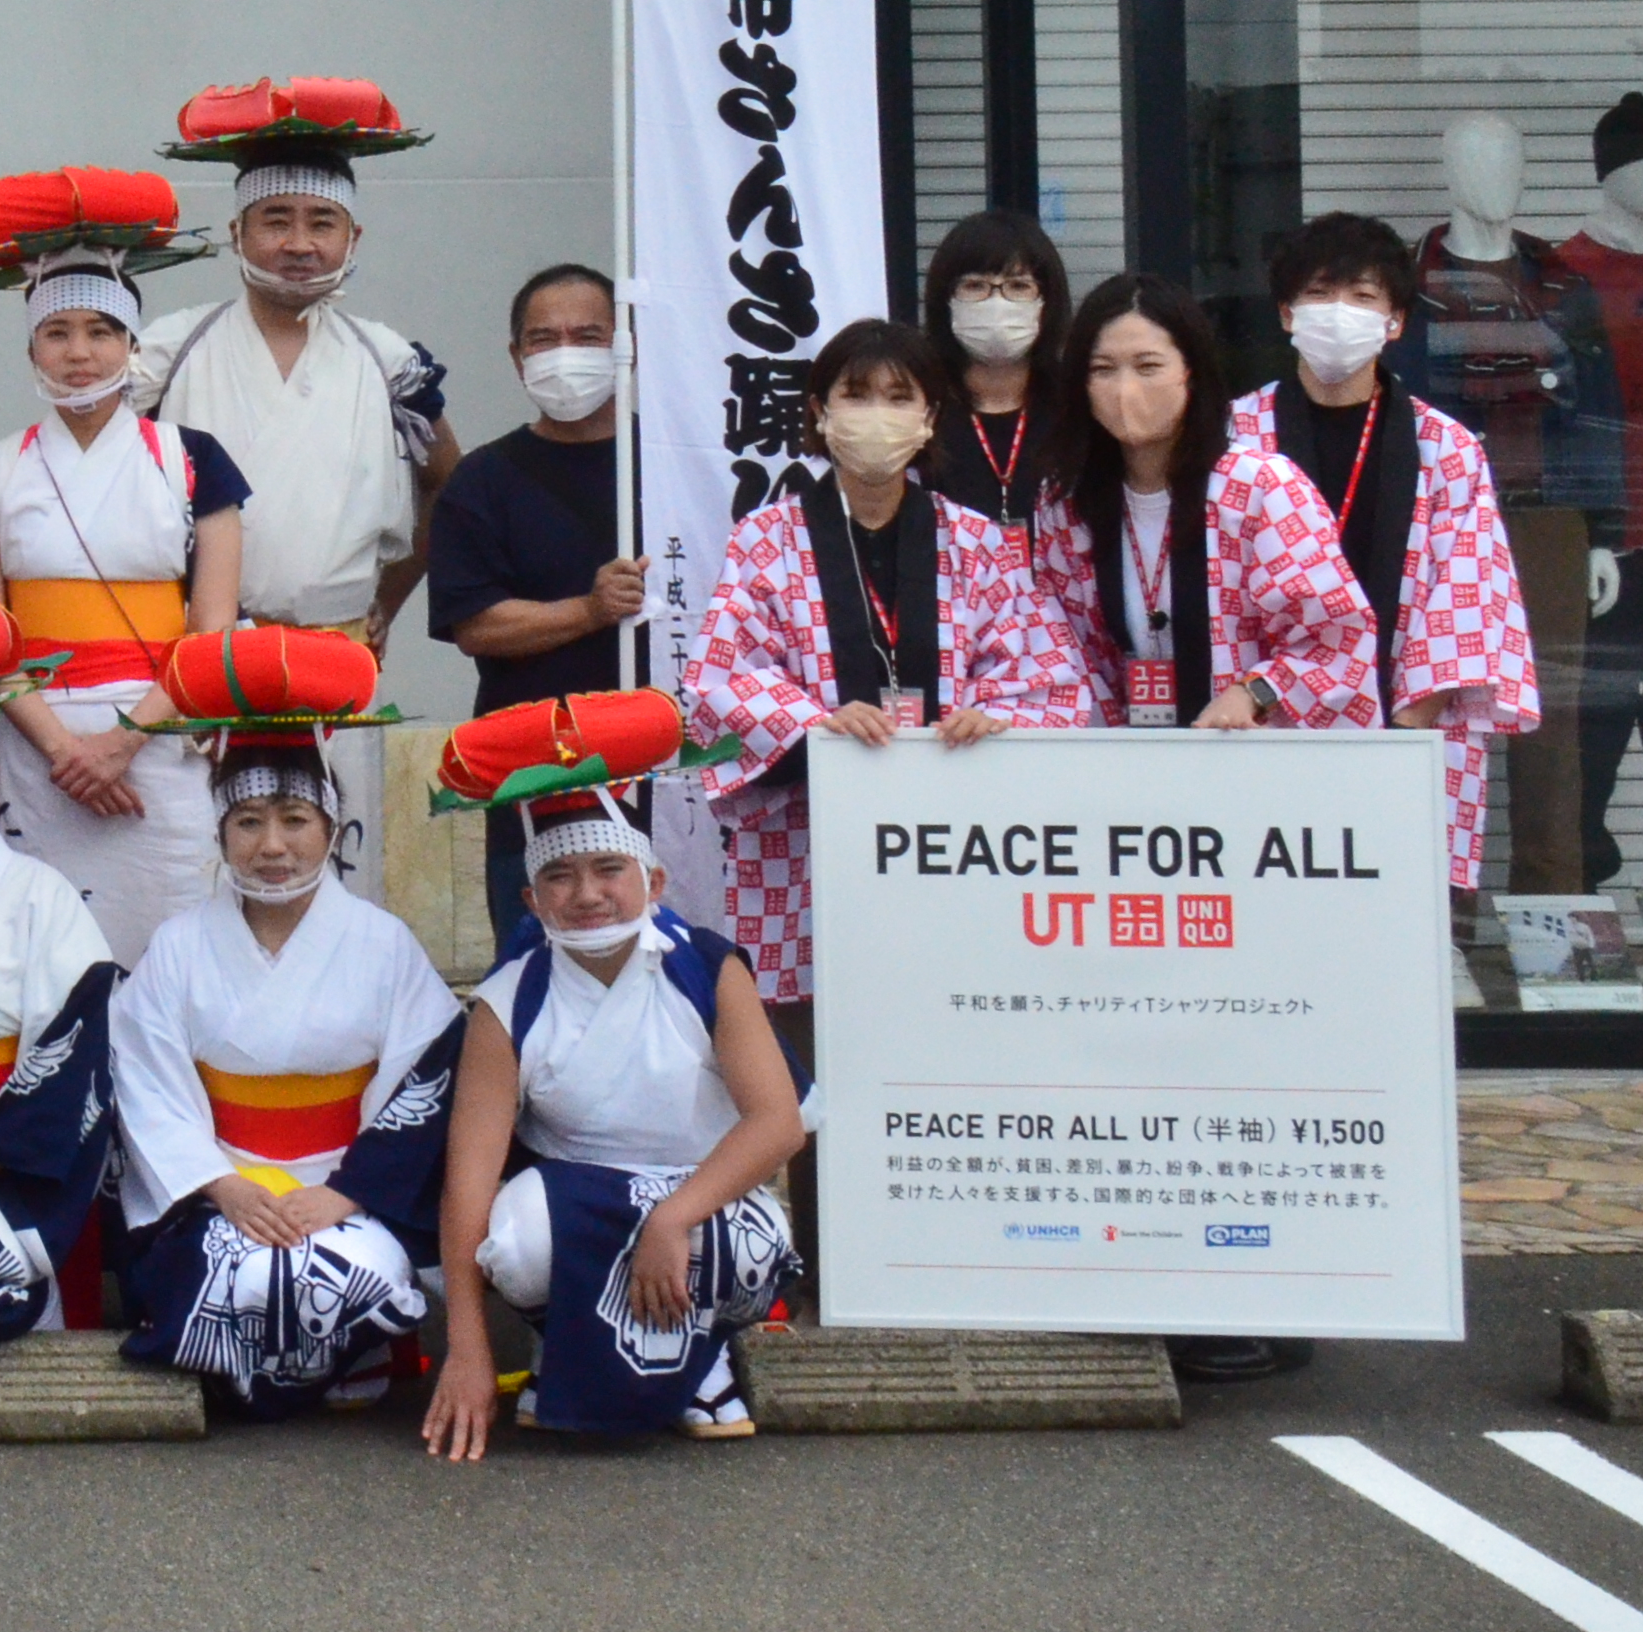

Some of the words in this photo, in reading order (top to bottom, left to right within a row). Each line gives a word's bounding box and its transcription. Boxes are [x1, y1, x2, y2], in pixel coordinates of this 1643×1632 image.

[876, 824, 1079, 876] PEACE
[1108, 825, 1224, 877] FOR
[1253, 827, 1380, 879] ALL
[1022, 892, 1095, 947] UT
[886, 1112, 984, 1139] PEACE
[998, 1114, 1054, 1140] FOR
[1068, 1115, 1128, 1141] ALL
[1141, 1116, 1179, 1142] UT
[1291, 1118, 1385, 1147] ¥1,500
[1027, 1225, 1081, 1237] UNHCR
[1231, 1228, 1268, 1239] PLAN
